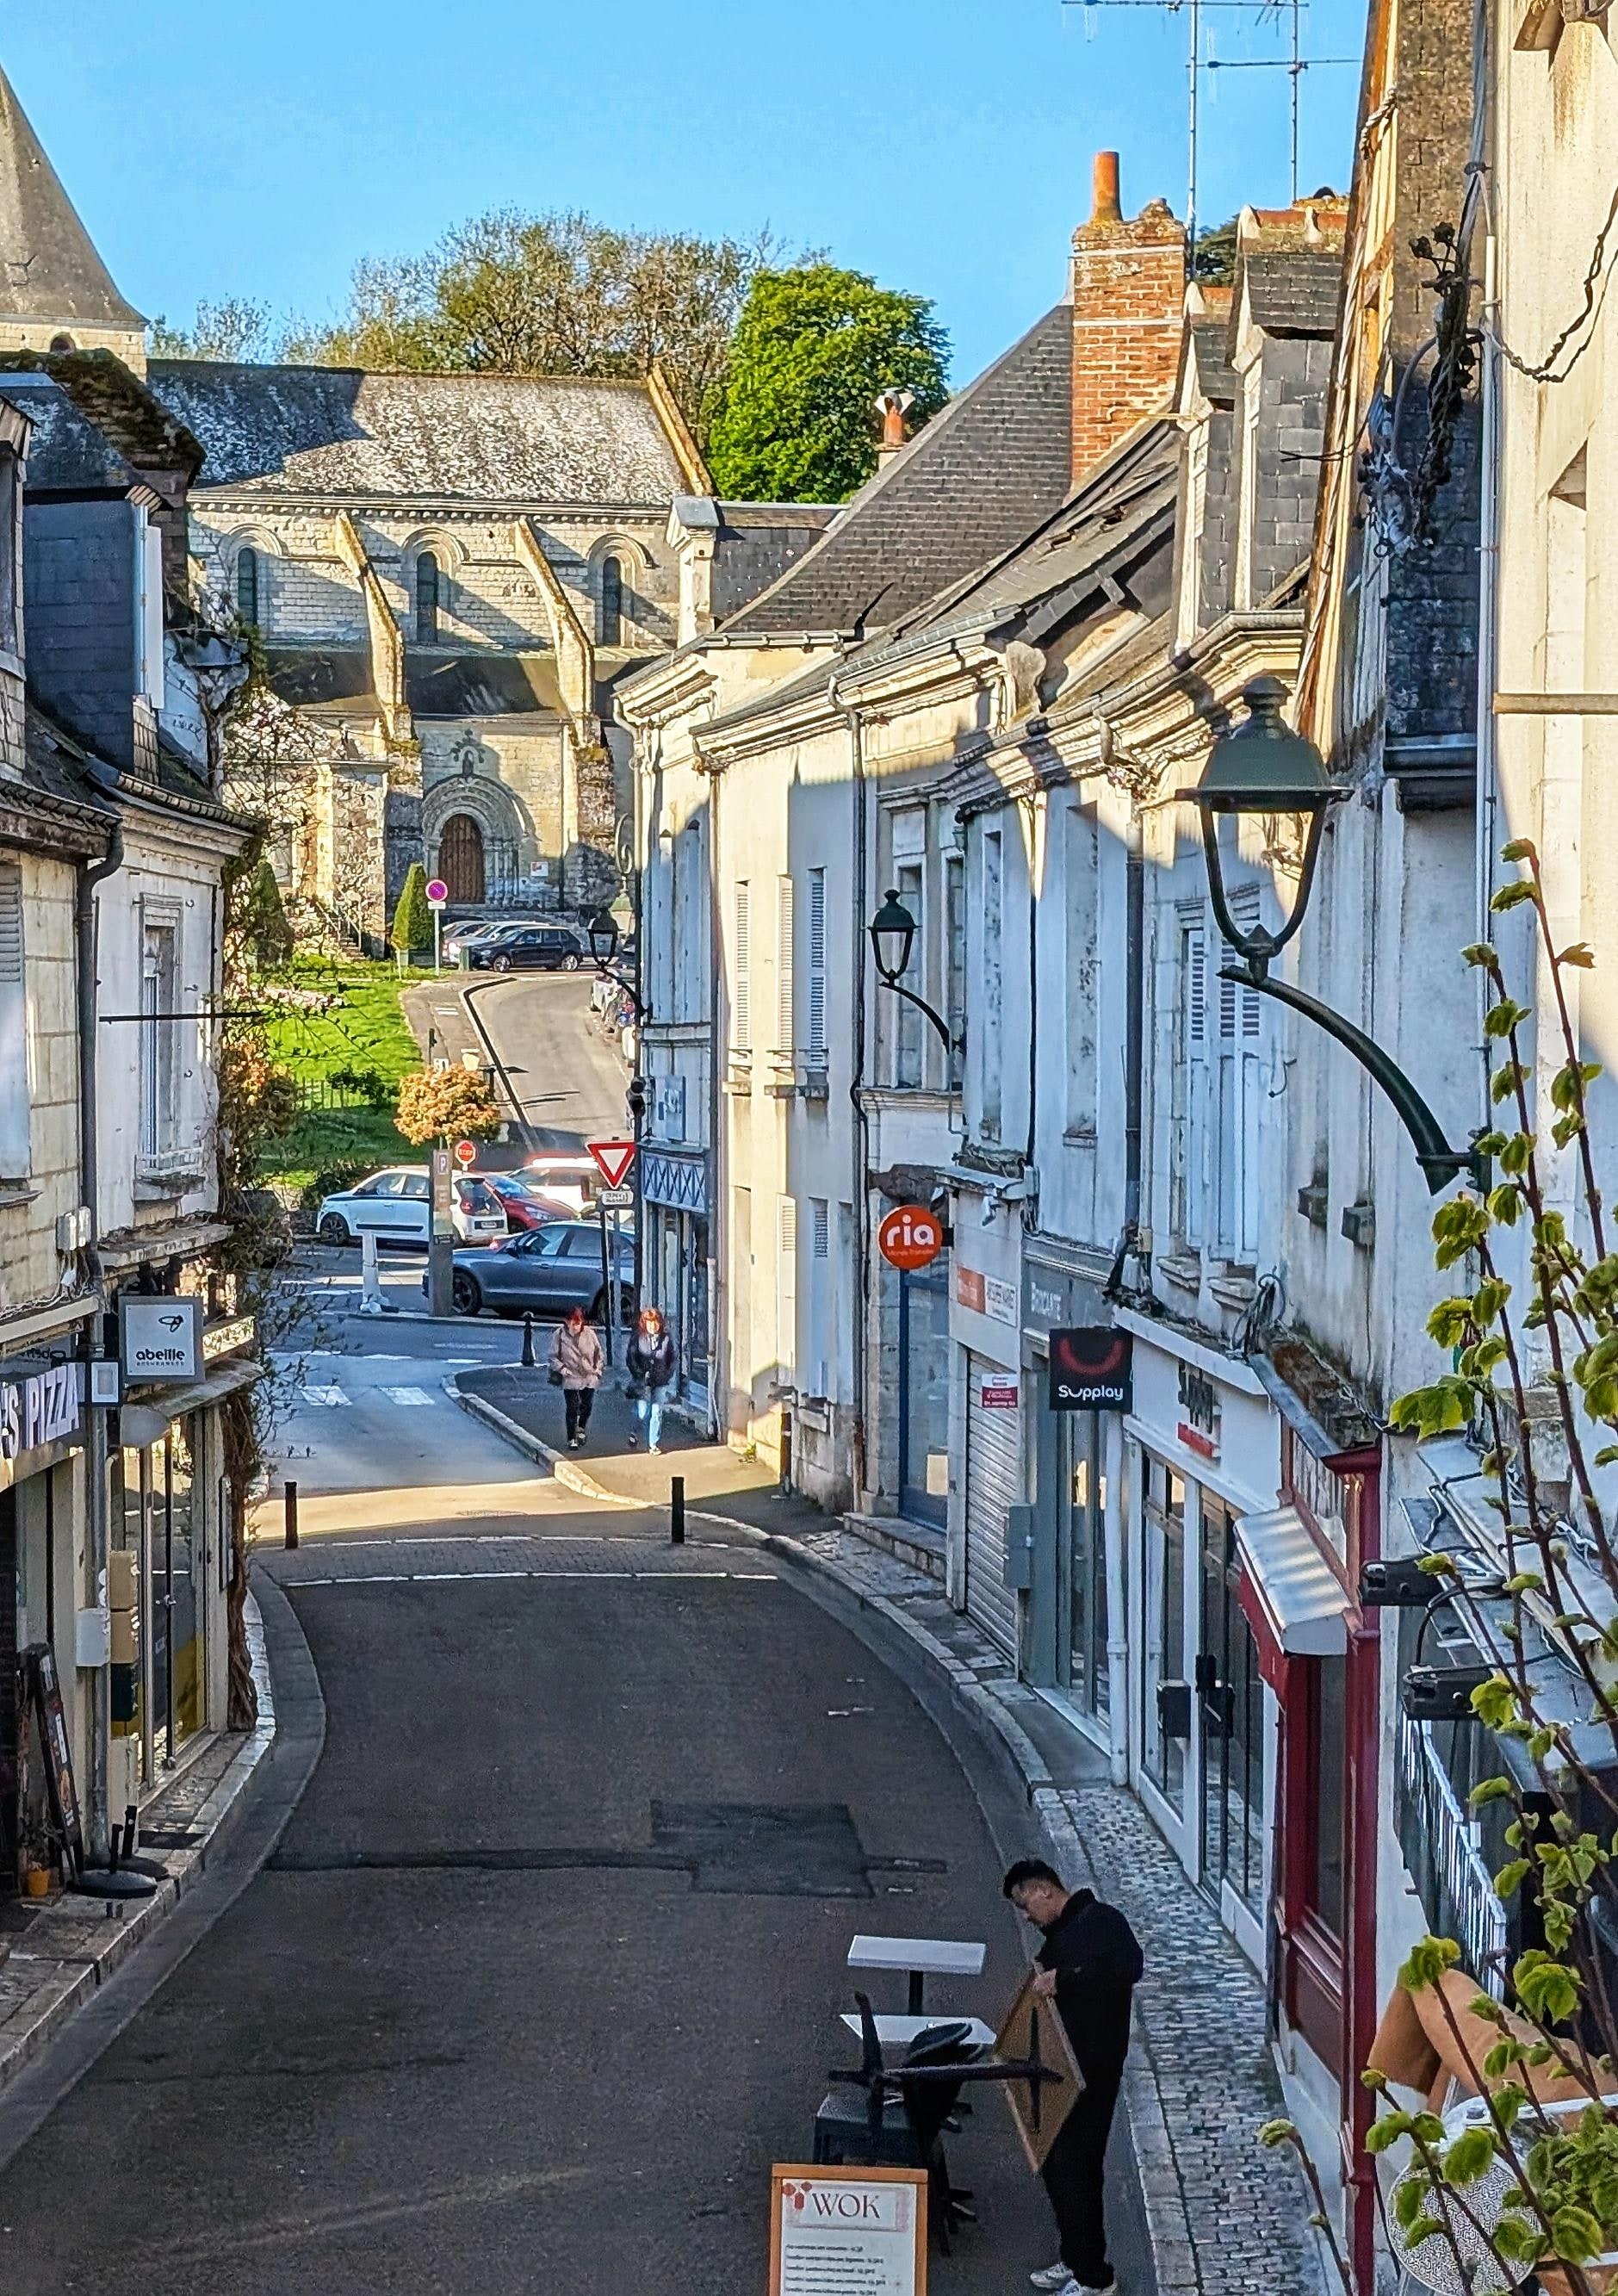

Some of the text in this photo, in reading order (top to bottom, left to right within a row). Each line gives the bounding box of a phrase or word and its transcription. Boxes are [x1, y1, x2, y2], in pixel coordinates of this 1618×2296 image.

[886, 1213, 935, 1247] ria
[135, 1348, 186, 1361] abeille
[1057, 1384, 1124, 1401] Supplay
[25, 1362, 80, 1450] PIZZA
[811, 2193, 880, 2219] WOK
